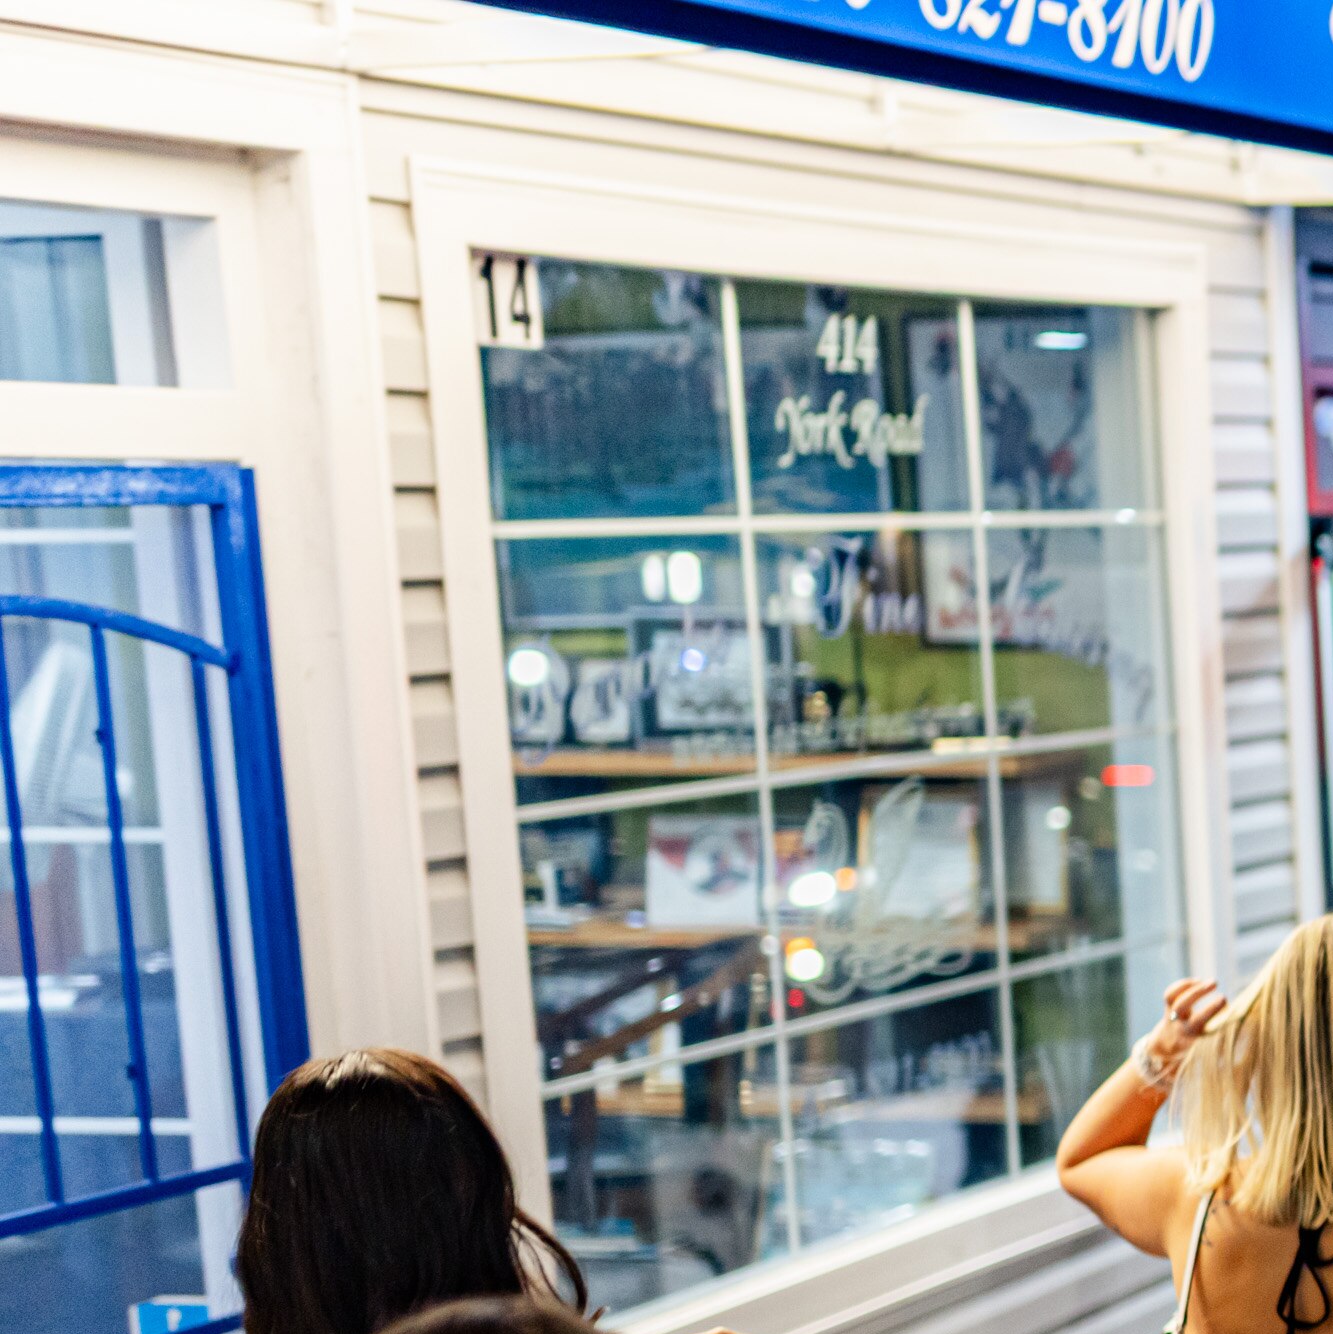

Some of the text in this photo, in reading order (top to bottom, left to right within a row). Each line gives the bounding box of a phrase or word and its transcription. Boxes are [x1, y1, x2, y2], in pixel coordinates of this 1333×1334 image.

[816, 313, 880, 374] 414
[774, 390, 929, 469] York Road
